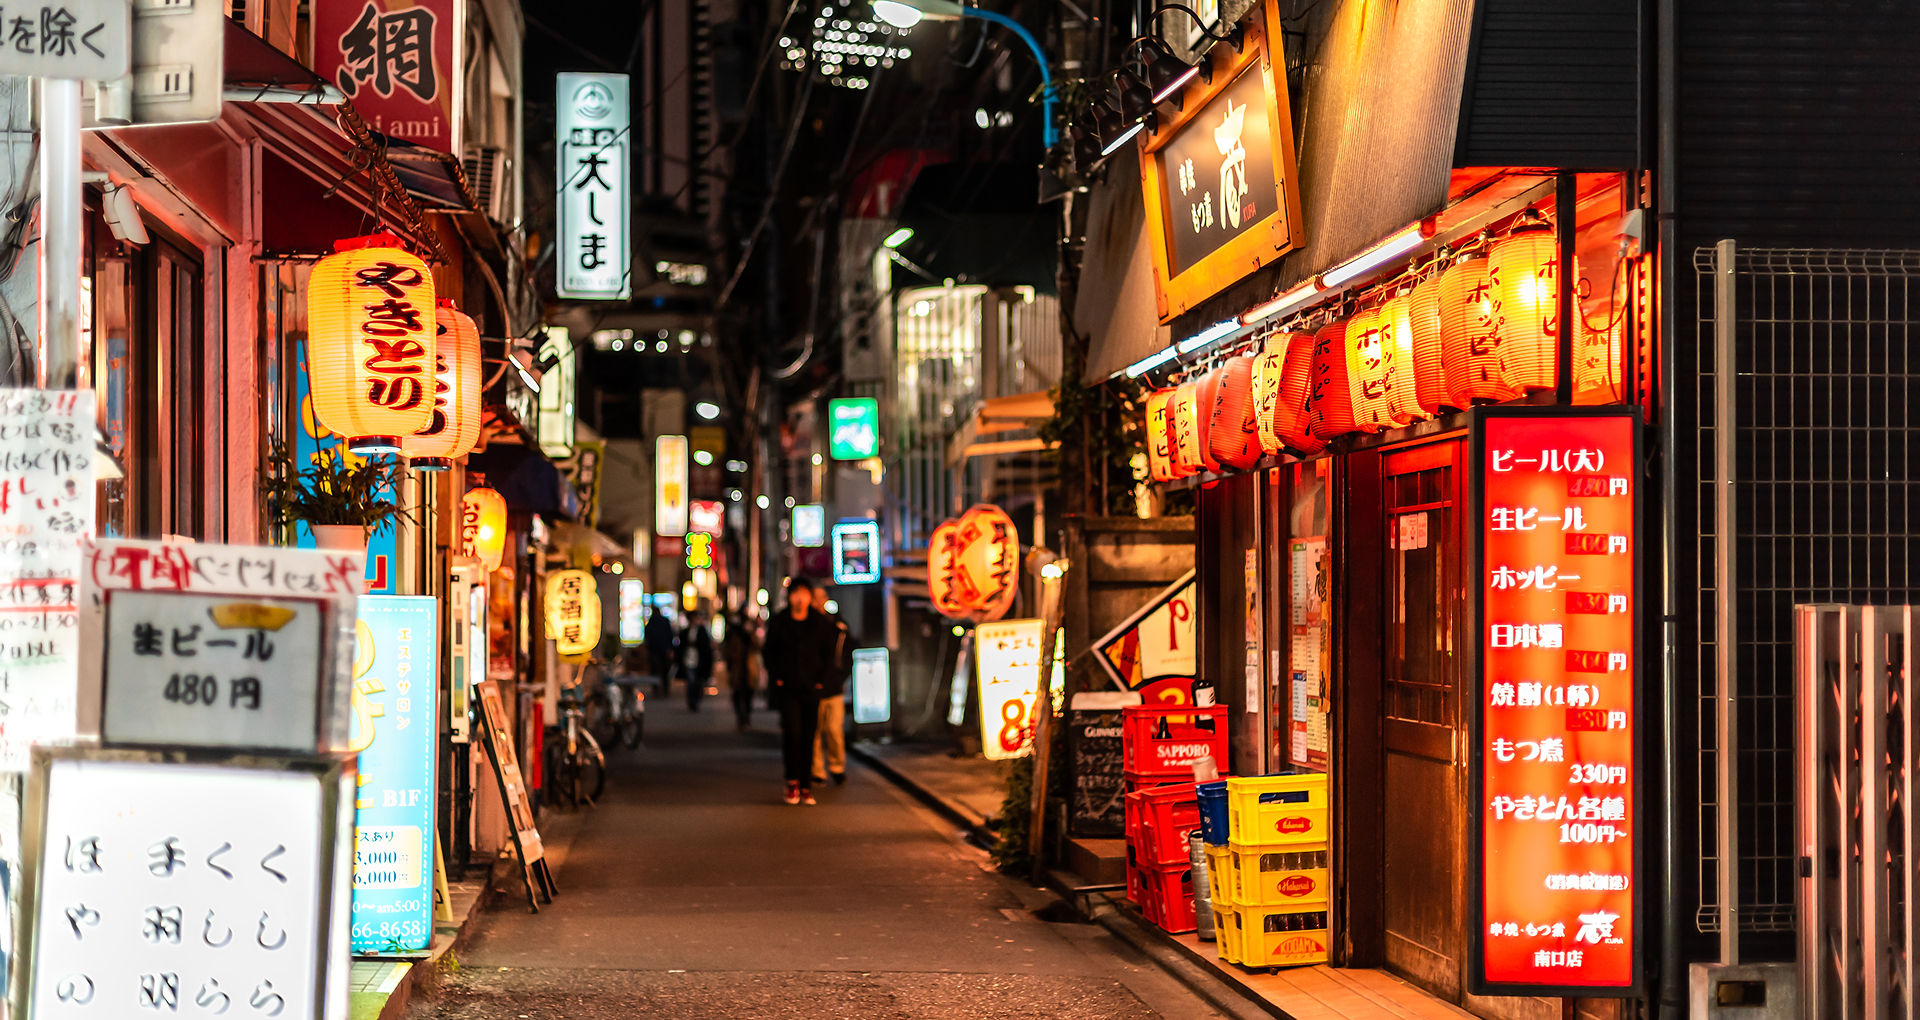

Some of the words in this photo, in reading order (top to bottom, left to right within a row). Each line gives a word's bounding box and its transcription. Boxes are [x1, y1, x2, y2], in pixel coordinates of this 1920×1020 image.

[0, 6, 105, 58] を除く
[337, 2, 437, 103] 網
[389, 116, 440, 137] ami
[574, 152, 611, 269] 大しま
[1313, 338, 1332, 421] ホッピー
[1356, 327, 1384, 422] ホッピー
[1263, 350, 1280, 433] ホッピー
[1491, 507, 1588, 531] 生ビール
[1491, 566, 1581, 590] ホッピー
[132, 622, 275, 662] 生ビール
[1491, 624, 1563, 648] 日本酒
[396, 628, 412, 731] エステサロン
[1157, 744, 1210, 758] SAPPORO
[1492, 738, 1565, 763] もつ煮
[1569, 764, 1627, 785] 330円
[382, 789, 421, 807] B1F
[1490, 796, 1626, 821] やきとん各種
[354, 831, 394, 842] スあり
[1280, 938, 1317, 953] KODAMA
[1534, 950, 1584, 968] 南口店
